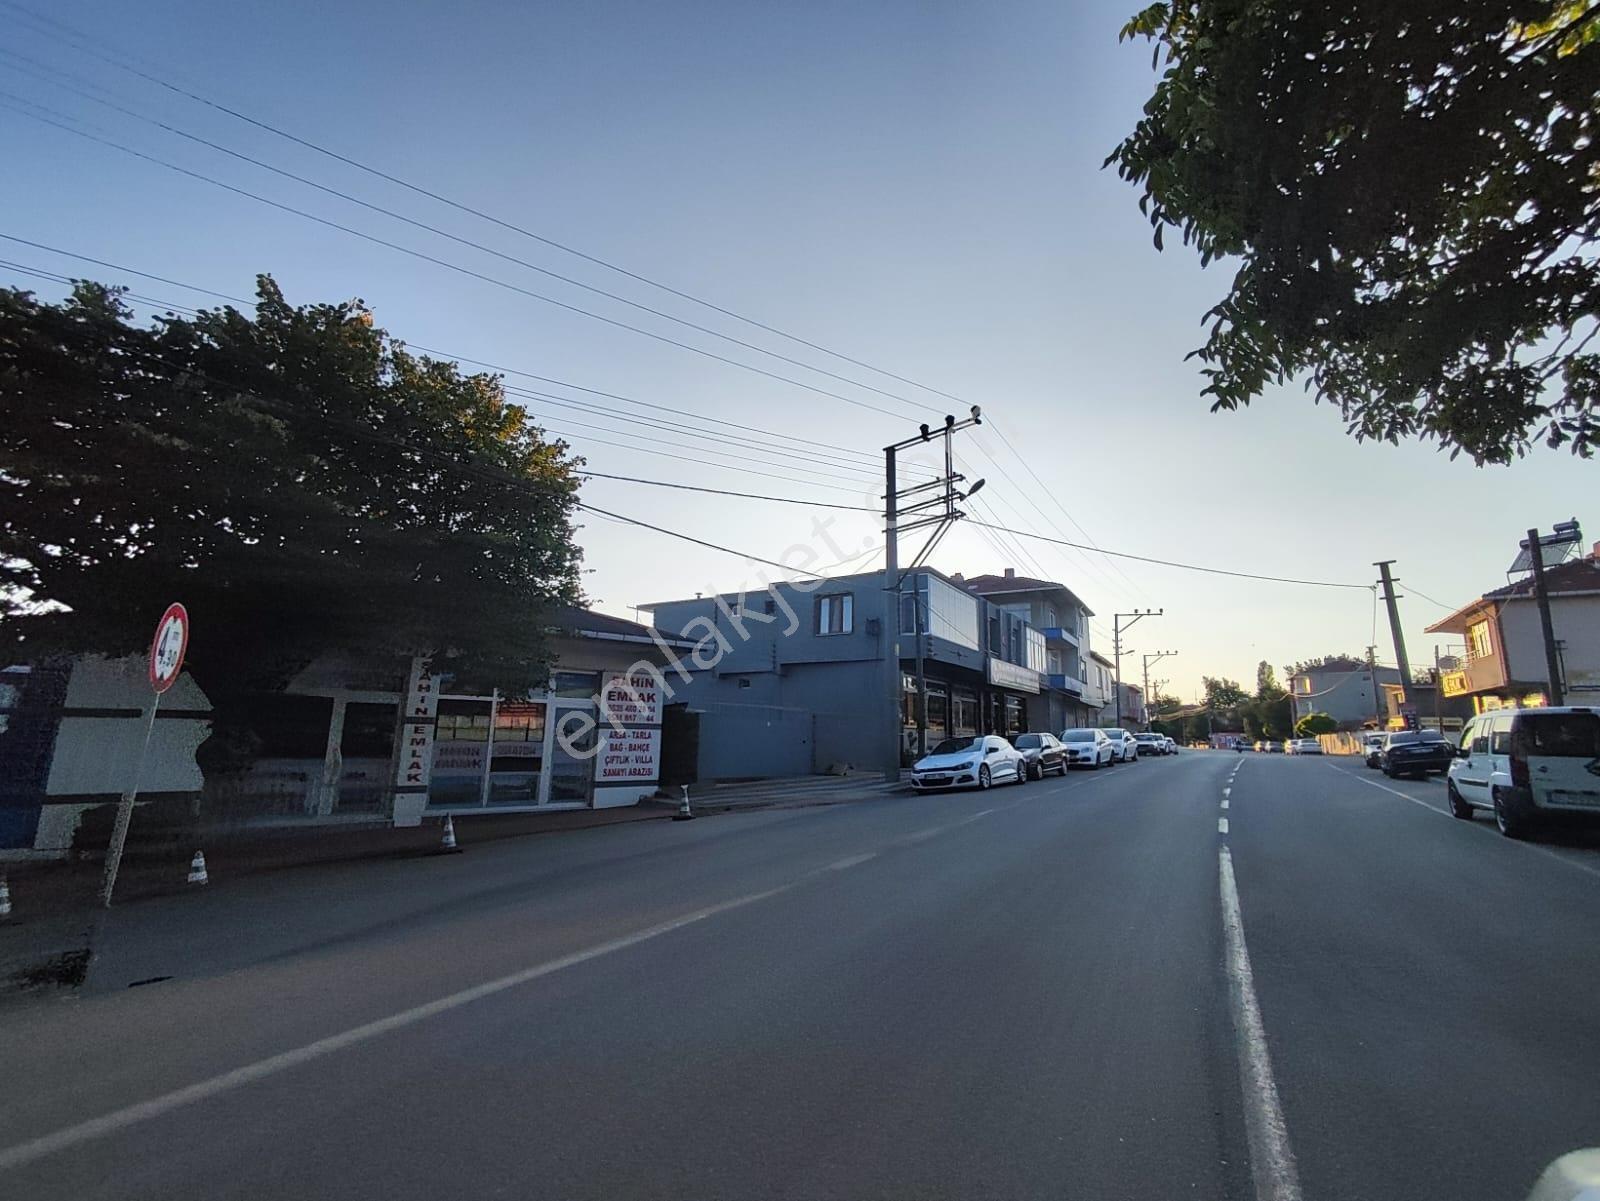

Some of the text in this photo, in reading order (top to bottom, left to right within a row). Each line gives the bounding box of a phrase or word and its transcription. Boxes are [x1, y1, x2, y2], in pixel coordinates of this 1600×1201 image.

[607, 690, 656, 703] EMLAK
[632, 731, 652, 739] TARLA
[629, 743, 650, 752] BAHÇE
[407, 726, 426, 782] EMLAK
